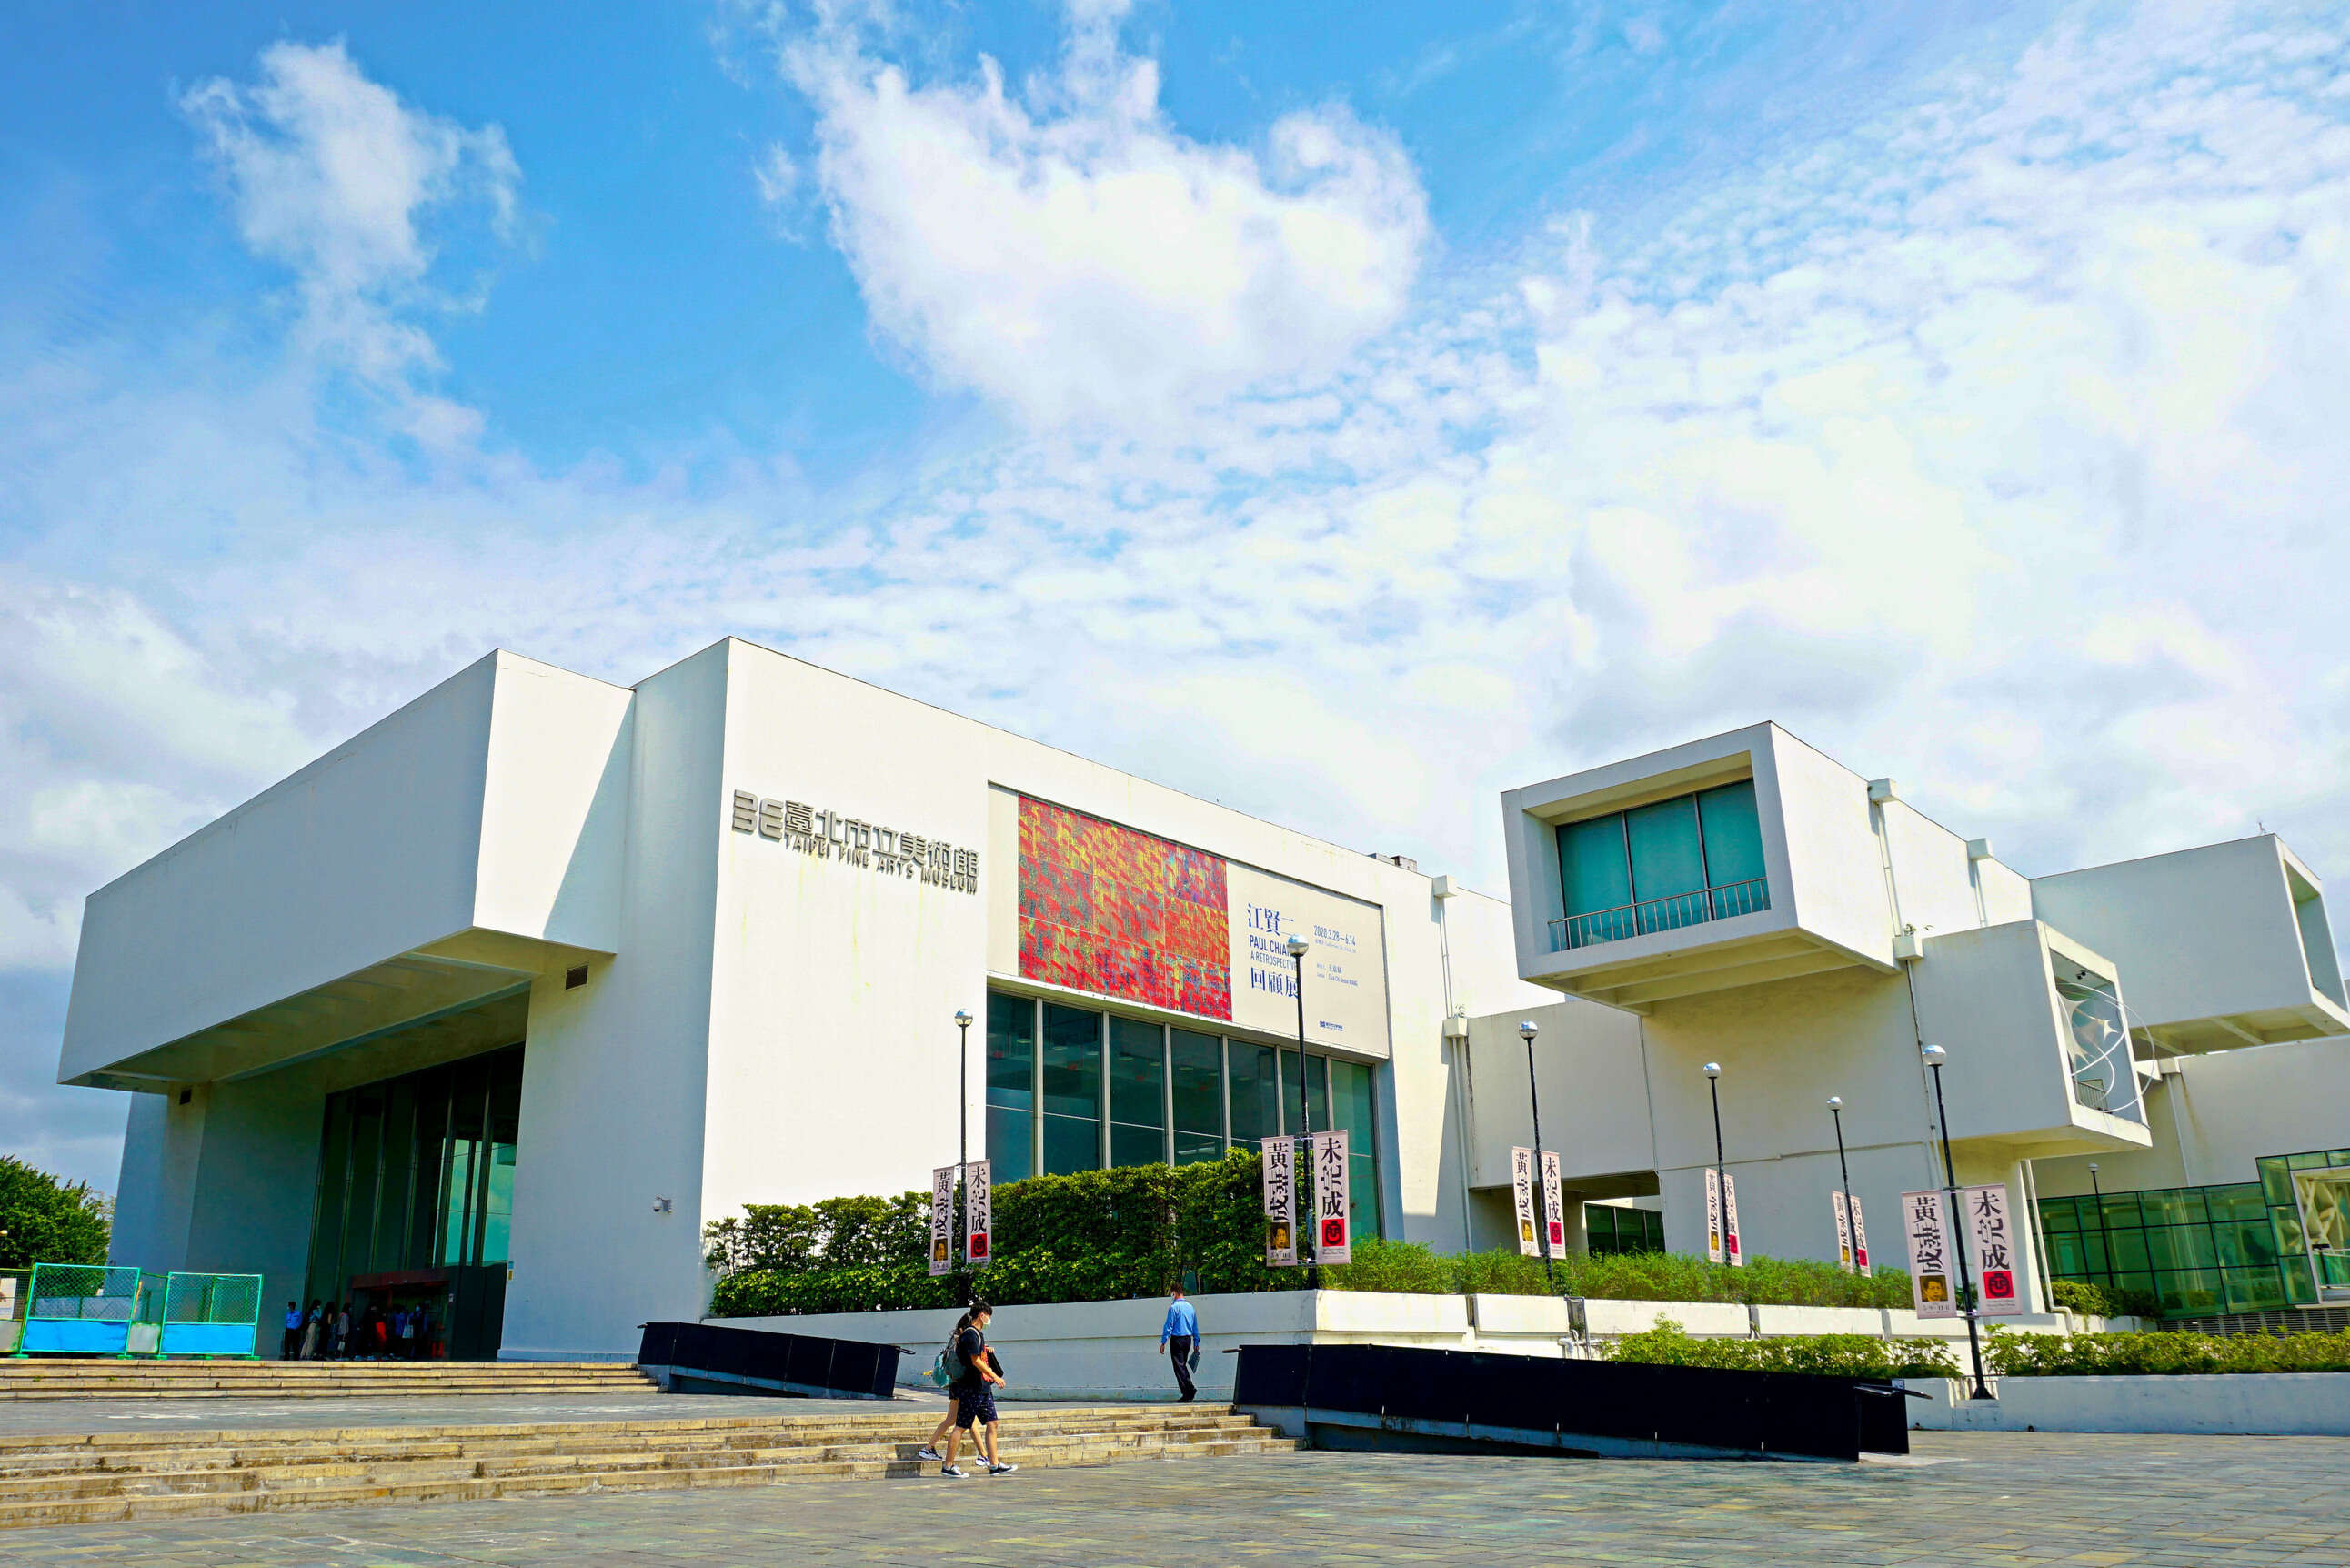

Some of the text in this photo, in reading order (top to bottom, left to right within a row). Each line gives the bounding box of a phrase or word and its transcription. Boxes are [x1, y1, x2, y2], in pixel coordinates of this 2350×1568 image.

[785, 799, 979, 879] 臺北市立美術館
[784, 832, 978, 895] TAIPEI FINE ARTS MUSEUM
[1250, 934, 1292, 958] PAUL CHIA
[1251, 966, 1299, 1000] 回顧展
